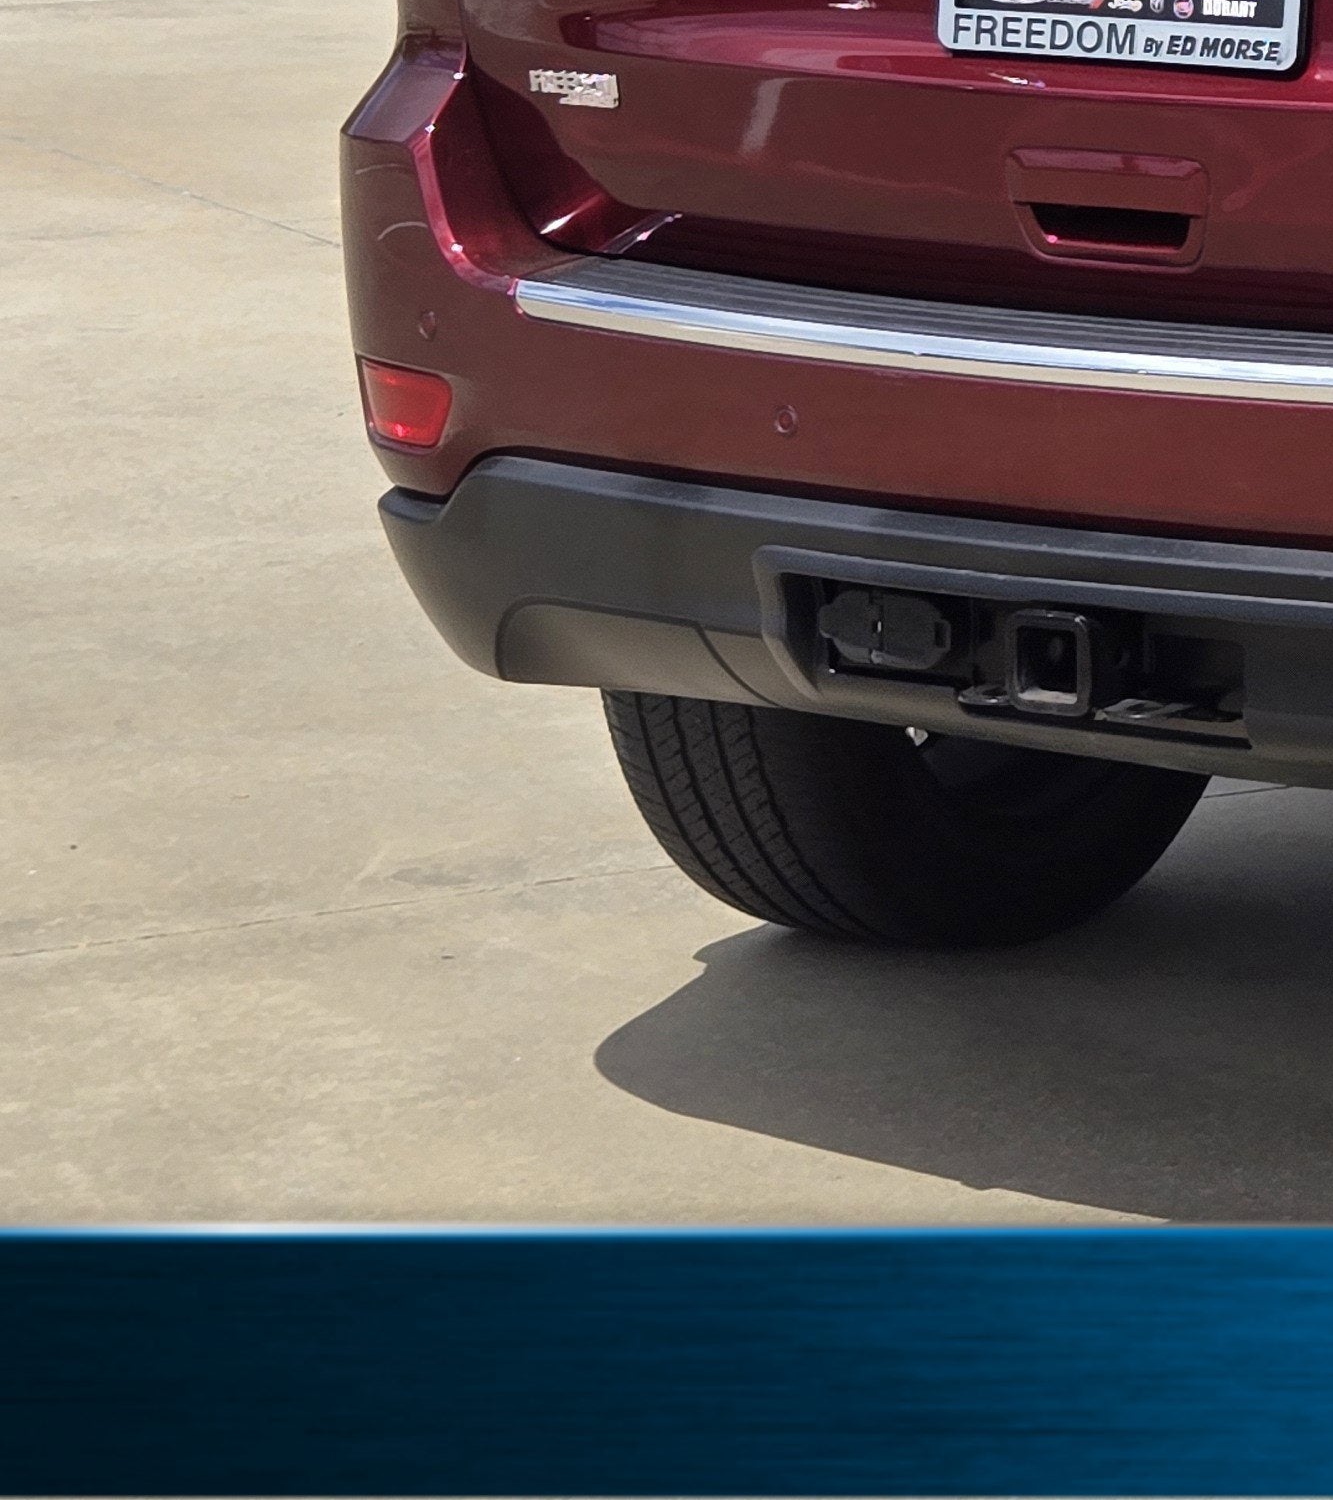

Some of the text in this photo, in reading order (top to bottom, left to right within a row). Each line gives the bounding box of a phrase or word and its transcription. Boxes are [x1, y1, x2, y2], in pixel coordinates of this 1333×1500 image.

[952, 12, 1282, 62] FREEDOM By ED MORSE
